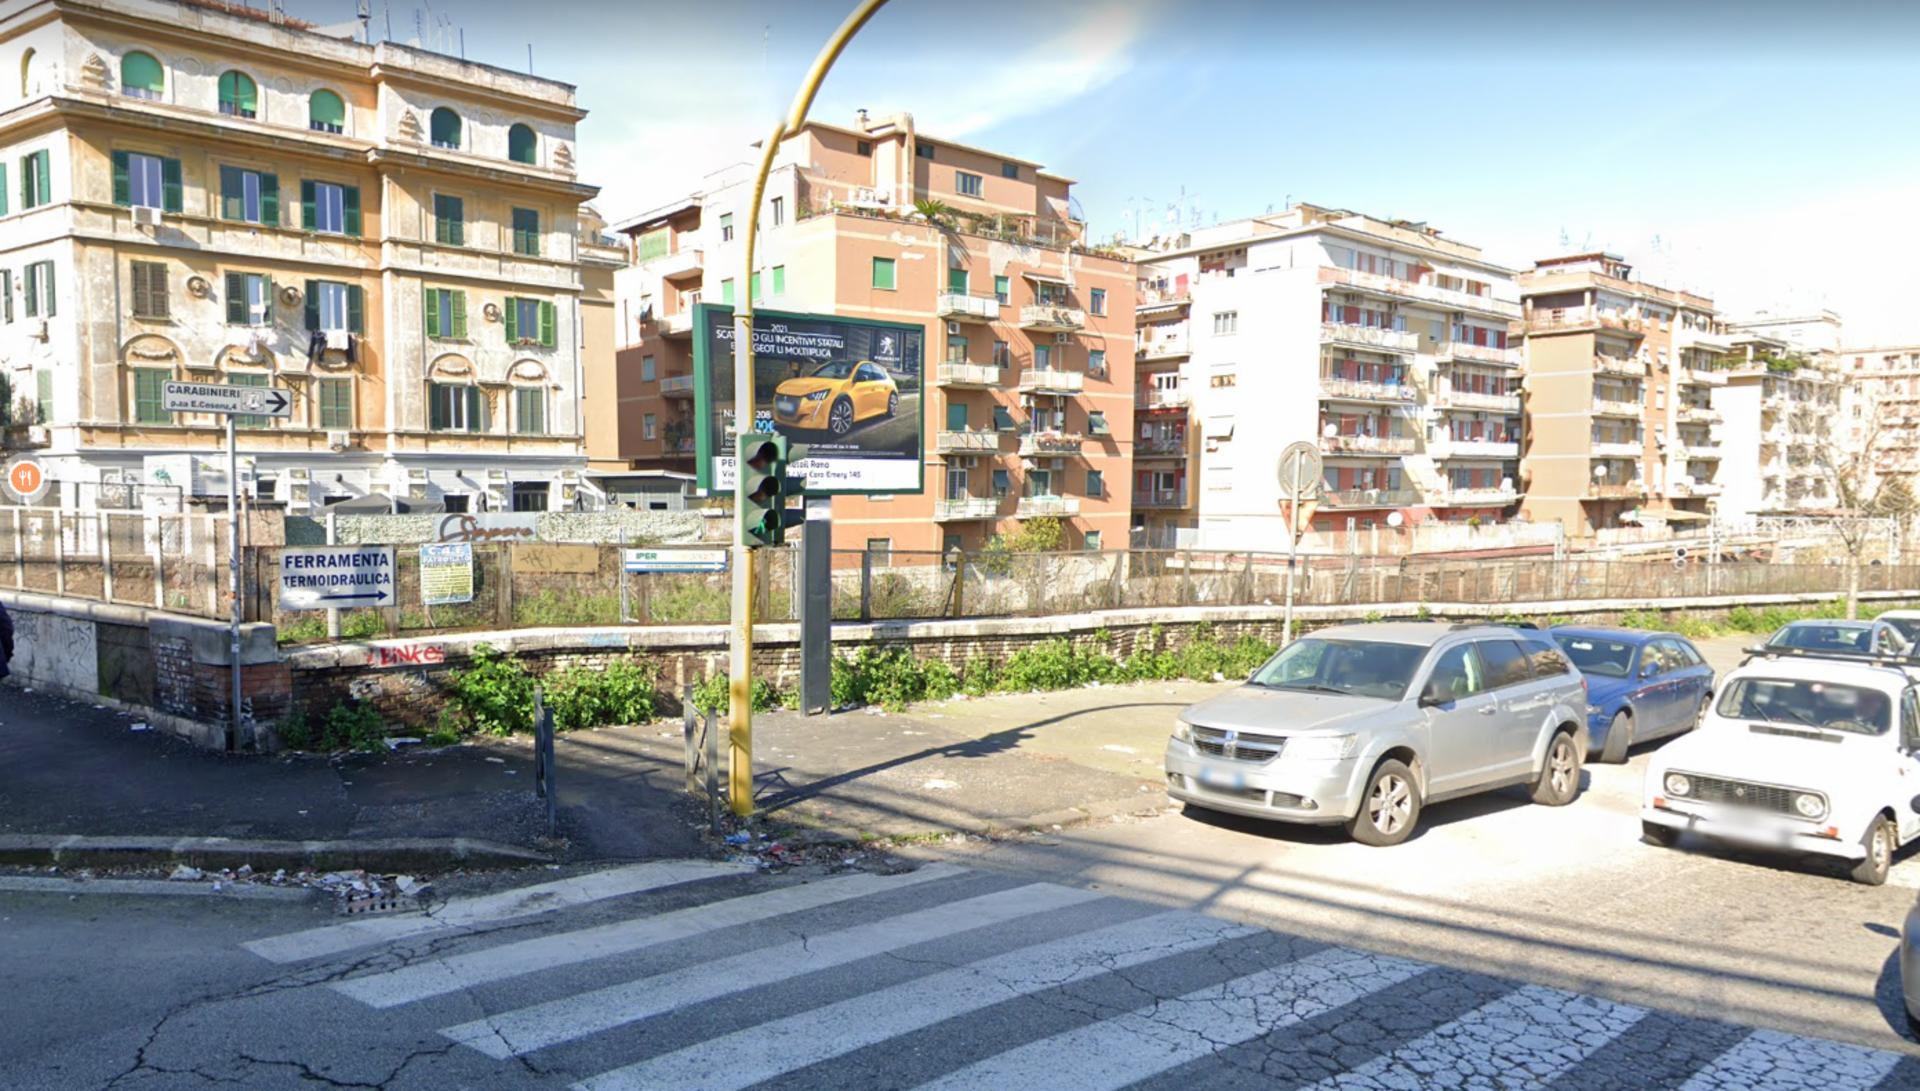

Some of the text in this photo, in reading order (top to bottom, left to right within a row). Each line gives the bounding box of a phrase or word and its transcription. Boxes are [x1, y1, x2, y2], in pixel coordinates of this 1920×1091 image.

[771, 324, 788, 333] 2021
[760, 334, 774, 343] GLI
[817, 339, 844, 349] STATALI
[777, 346, 784, 354] LI
[167, 385, 240, 398] CARABINIERI
[755, 410, 772, 419] 208
[285, 553, 389, 569] FERRAMENTA
[636, 552, 658, 560] IPER
[283, 573, 390, 588] TERMOIDRAULICA
